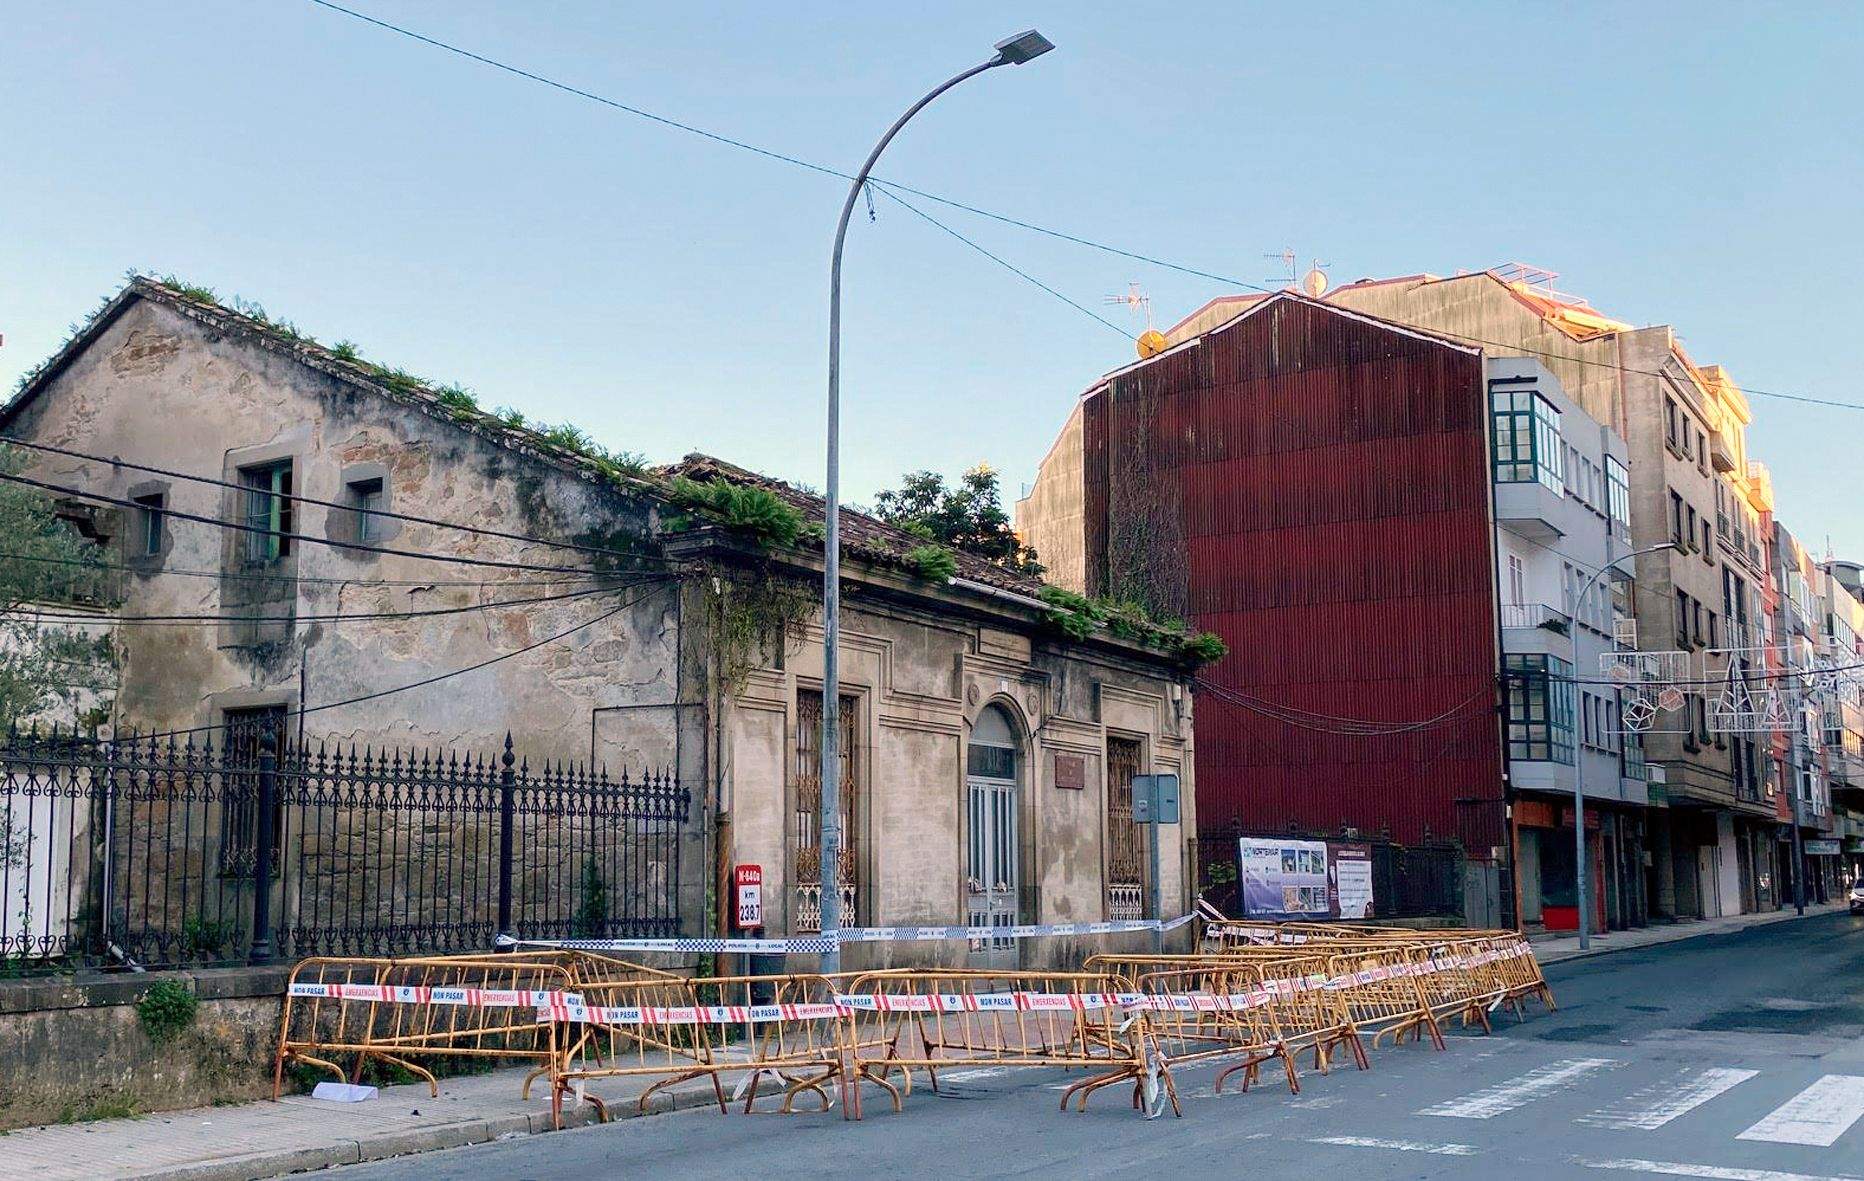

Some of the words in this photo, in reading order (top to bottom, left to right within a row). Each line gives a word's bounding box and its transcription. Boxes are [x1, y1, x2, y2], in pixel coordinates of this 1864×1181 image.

[306, 987, 325, 996] PASAR
[432, 991, 444, 1000] NON
[445, 992, 464, 1001] PASAR
[853, 998, 871, 1006] PASAR
[993, 998, 1012, 1006] PASAR
[620, 1011, 639, 1019] PASAR
[761, 1008, 779, 1017] PASAR
